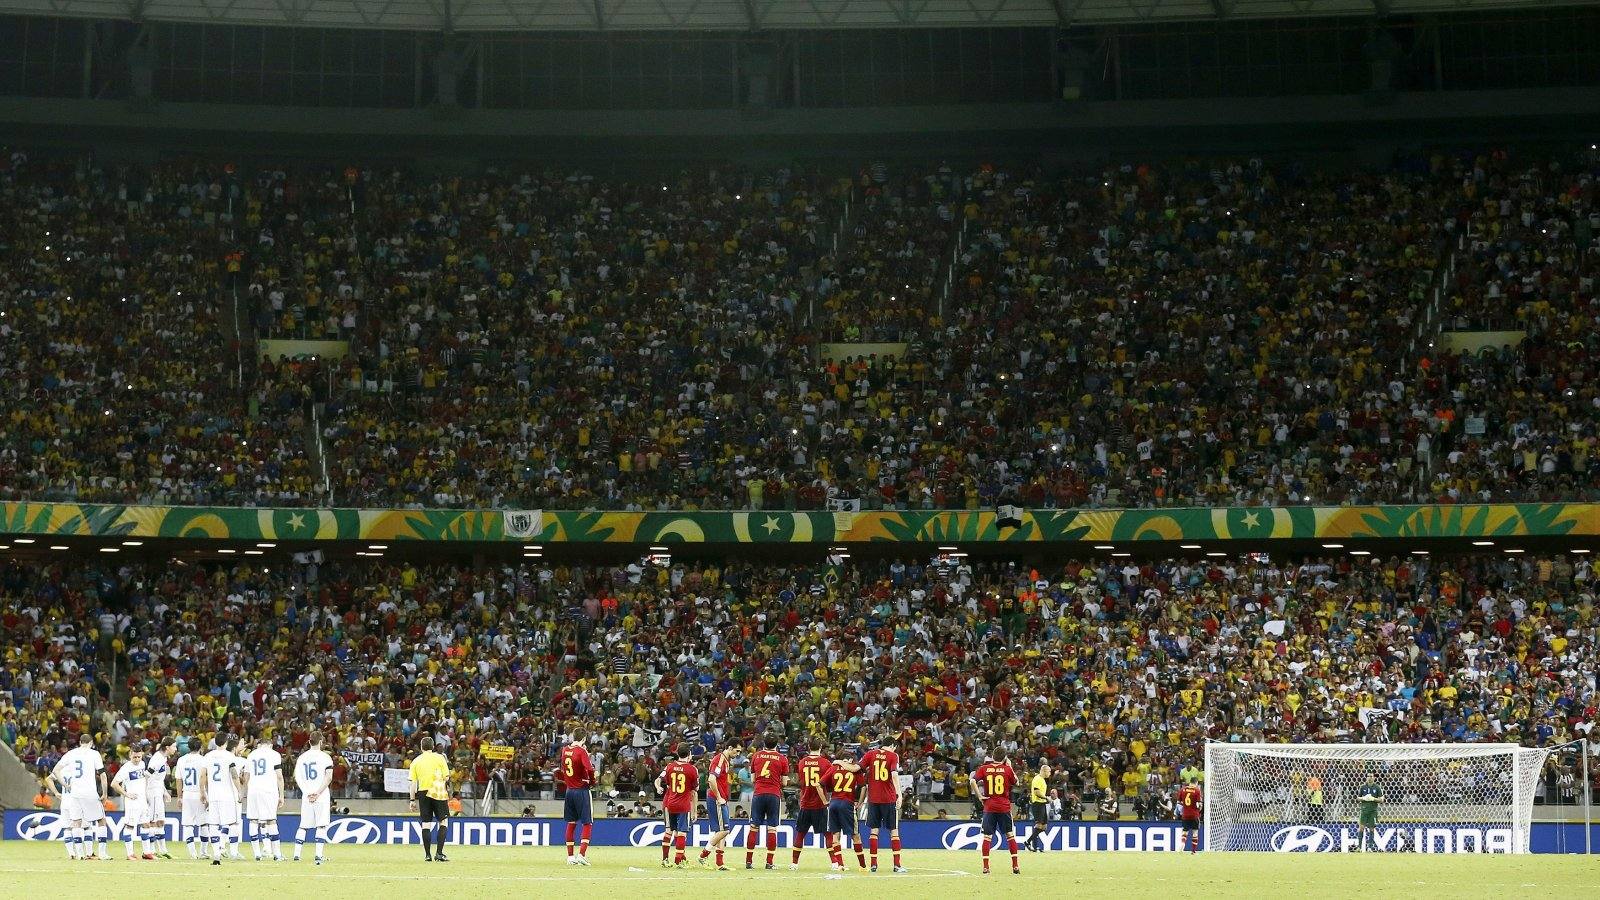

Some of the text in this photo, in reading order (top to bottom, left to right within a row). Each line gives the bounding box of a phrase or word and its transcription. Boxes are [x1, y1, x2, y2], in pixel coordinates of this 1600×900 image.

[75, 760, 83, 778] 3
[184, 767, 197, 786] 21
[213, 763, 221, 781] 2
[252, 758, 266, 776] 19
[303, 762, 318, 780] 16
[565, 757, 574, 777] 3
[803, 766, 820, 787] 15
[873, 760, 888, 781] 16
[670, 772, 686, 793] 13
[833, 771, 854, 792] 22
[986, 774, 1004, 795] 18
[1185, 792, 1191, 806] 6
[387, 820, 549, 846] HYUNDAI
